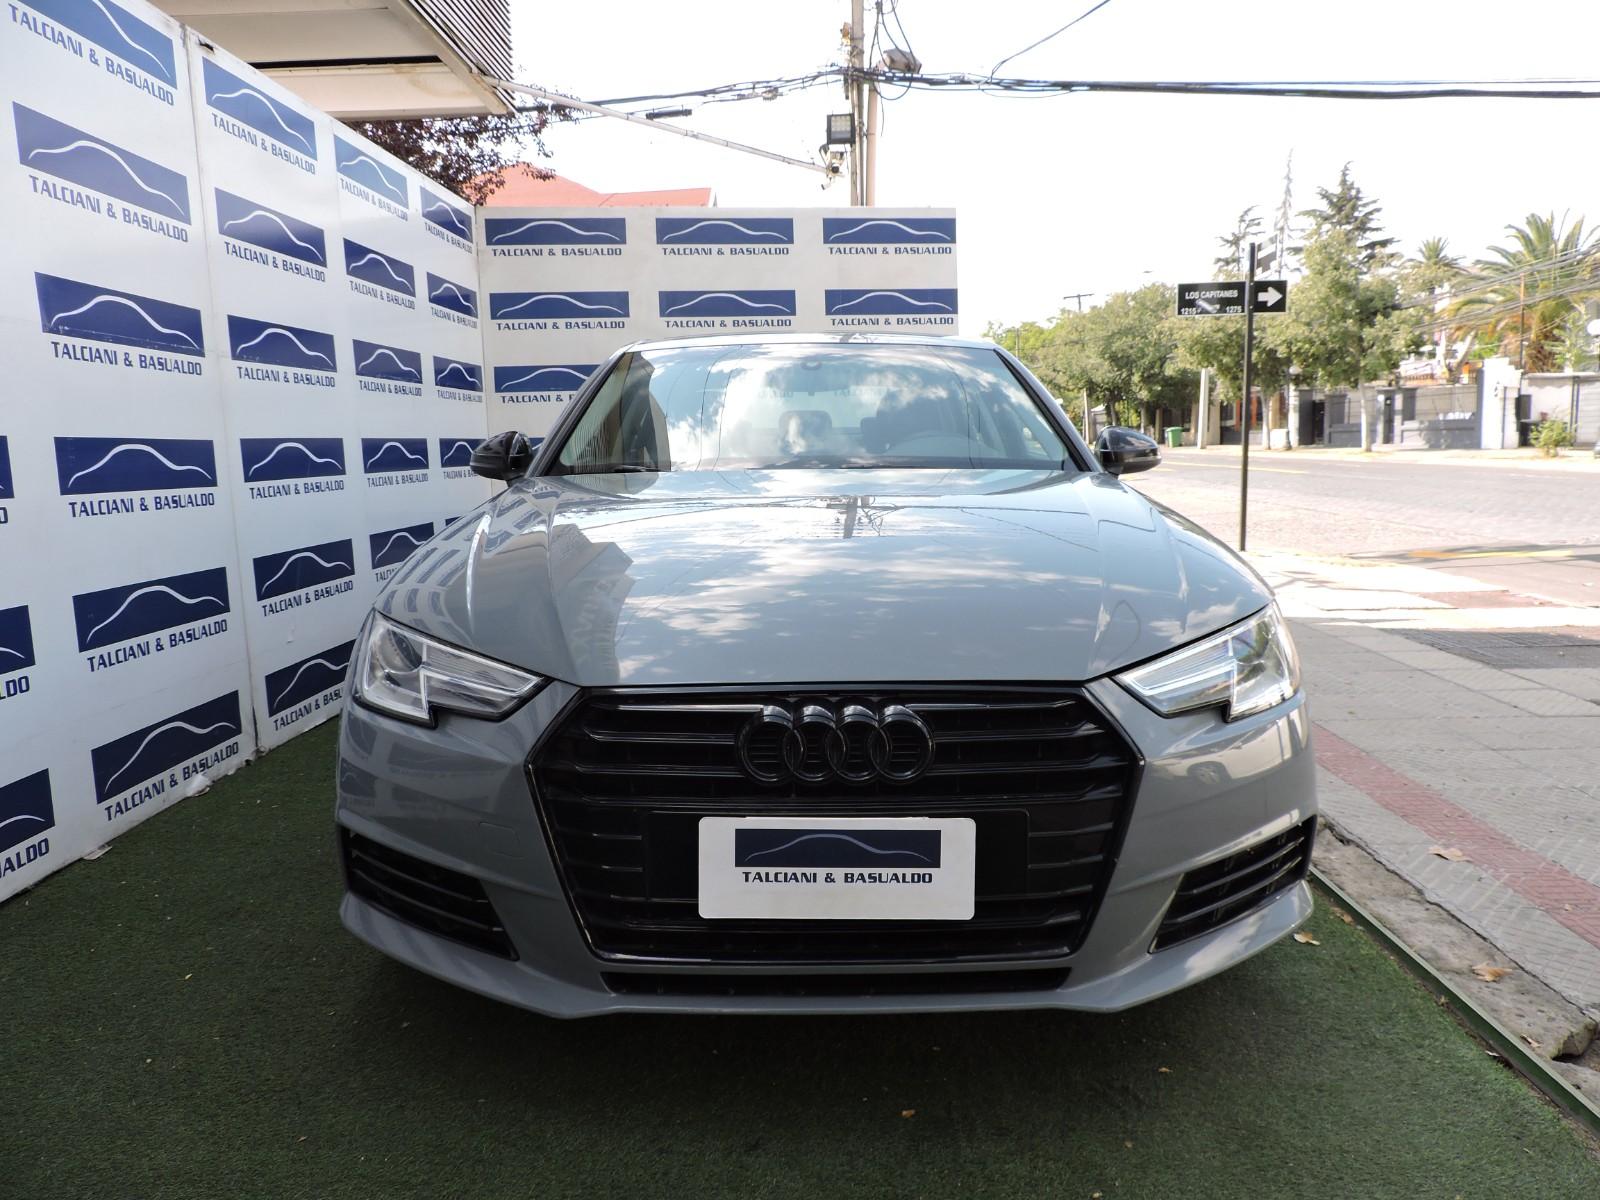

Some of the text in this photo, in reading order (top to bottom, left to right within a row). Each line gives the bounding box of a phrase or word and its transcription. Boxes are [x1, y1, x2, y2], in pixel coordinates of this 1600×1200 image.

[8, 3, 175, 106] TALCIANI & BASUALDO
[212, 113, 315, 174] TALCIANI & BASUALDO
[29, 174, 189, 243] TALCIANI & BASUALDO
[340, 178, 369, 204] TALCIANI
[378, 198, 408, 221] BASUALDO
[224, 241, 326, 282] TALCIANI & BASUALDO
[492, 247, 622, 257] TALCIANI & BASUALDO
[662, 247, 790, 256] TALCIANI & BASUALDO
[829, 246, 952, 255] TALCIANI & BASUALDO
[350, 280, 378, 300] TALCIANI
[386, 292, 416, 310] BASUALDO
[1185, 290, 1238, 299] LOS CAPITANES
[497, 320, 625, 330] TALCIANI & BASUALDO
[665, 319, 791, 328] TALCIANI & BASUALDO
[831, 317, 954, 326] TALCIANI & BASUALDO
[51, 341, 202, 376] TALCIANI & BASUALDO
[237, 366, 336, 388] TALCIANI & BASUALDO
[359, 380, 387, 394] TALCIANI
[394, 384, 422, 397] BASUALDO
[502, 395, 550, 403] TALCIANI
[249, 484, 291, 499] TALCIANI
[303, 480, 344, 494] BASUALDO
[367, 475, 393, 488] TALCIANI
[401, 472, 429, 484] BASUALDO
[69, 492, 216, 518] TALCIANI & BASUALDO
[262, 595, 303, 616] TALCIANI
[314, 580, 353, 600] BASUALDO
[87, 619, 228, 672] TALCIANI & BASUALDO
[273, 703, 312, 731] TALCIANI
[105, 741, 240, 822] TALCIANI & BASUALDO
[743, 872, 933, 883] TALCIANI & BASUALDO
